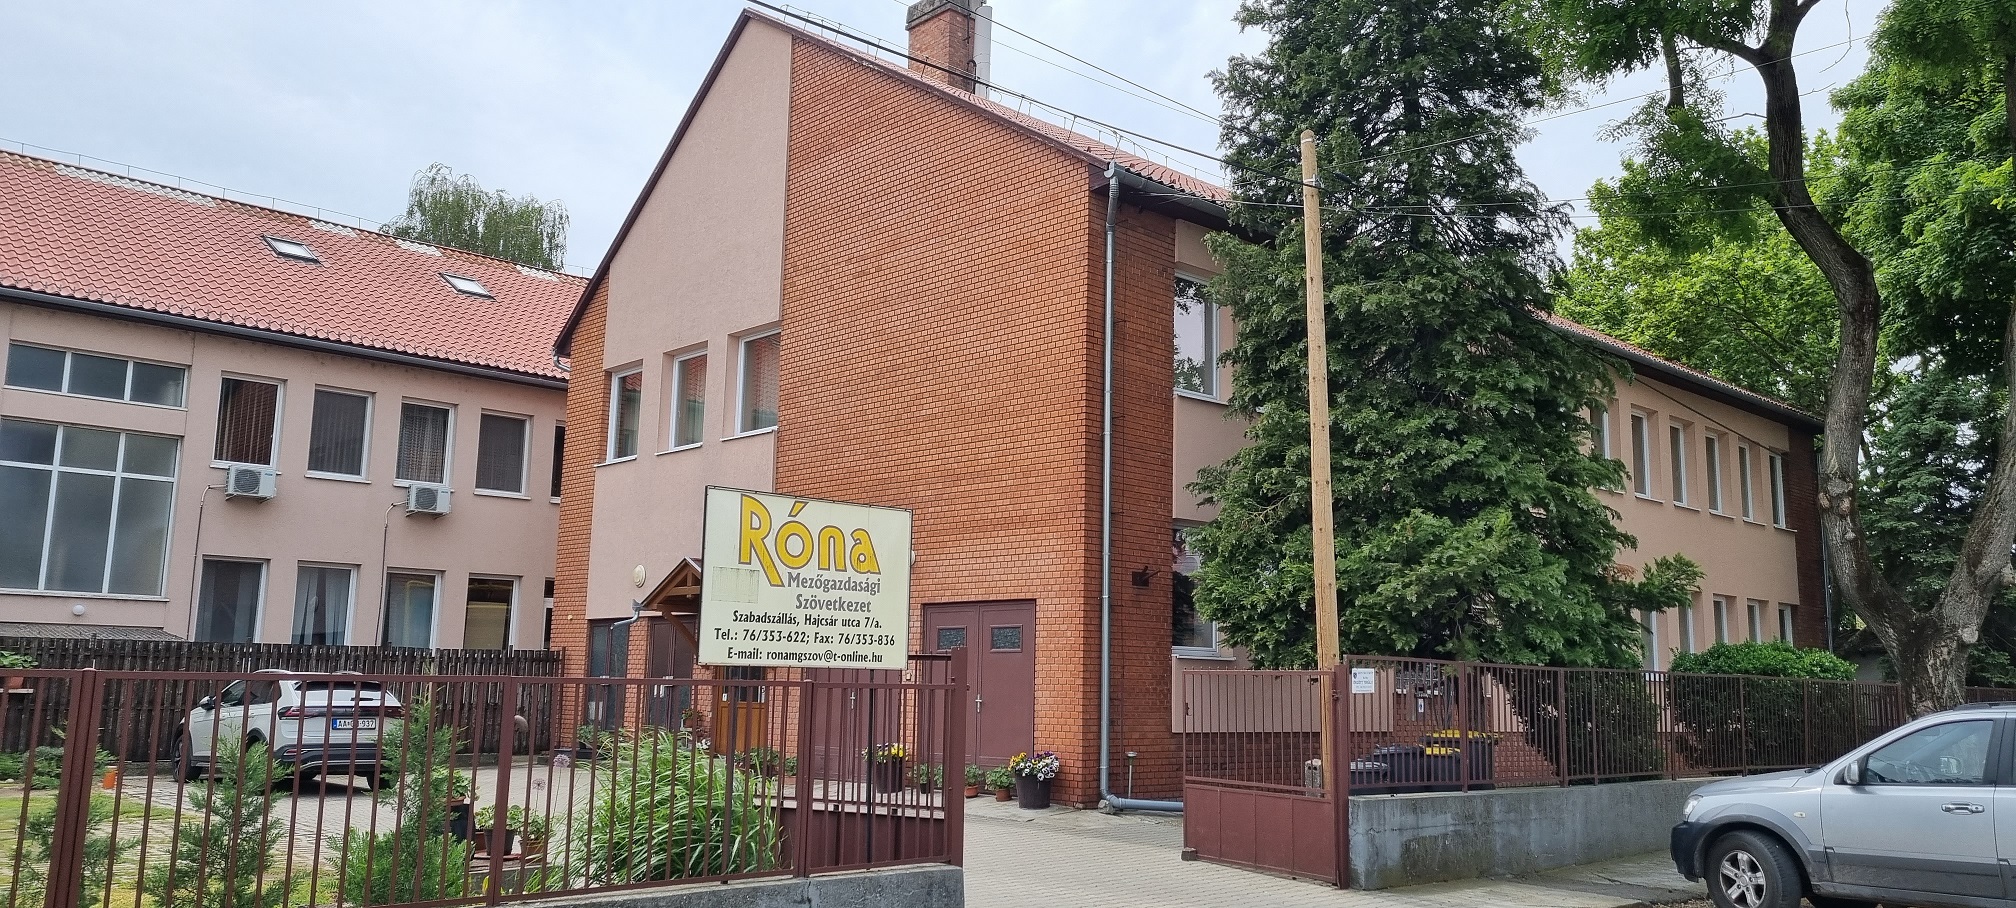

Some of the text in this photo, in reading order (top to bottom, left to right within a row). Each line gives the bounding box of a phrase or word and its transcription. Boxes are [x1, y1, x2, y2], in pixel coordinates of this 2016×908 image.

[738, 493, 882, 588] Róna
[787, 571, 881, 596] Mezőgazdasági
[795, 594, 872, 613] Szövetkezet
[732, 610, 882, 629] Szabadszállás, Hajcsár utca 7/a.
[714, 628, 895, 646] Tel.: 76/353-622; Fax: 76/353-836
[727, 647, 883, 663] E-mail: ronamgszov@t-online.hu
